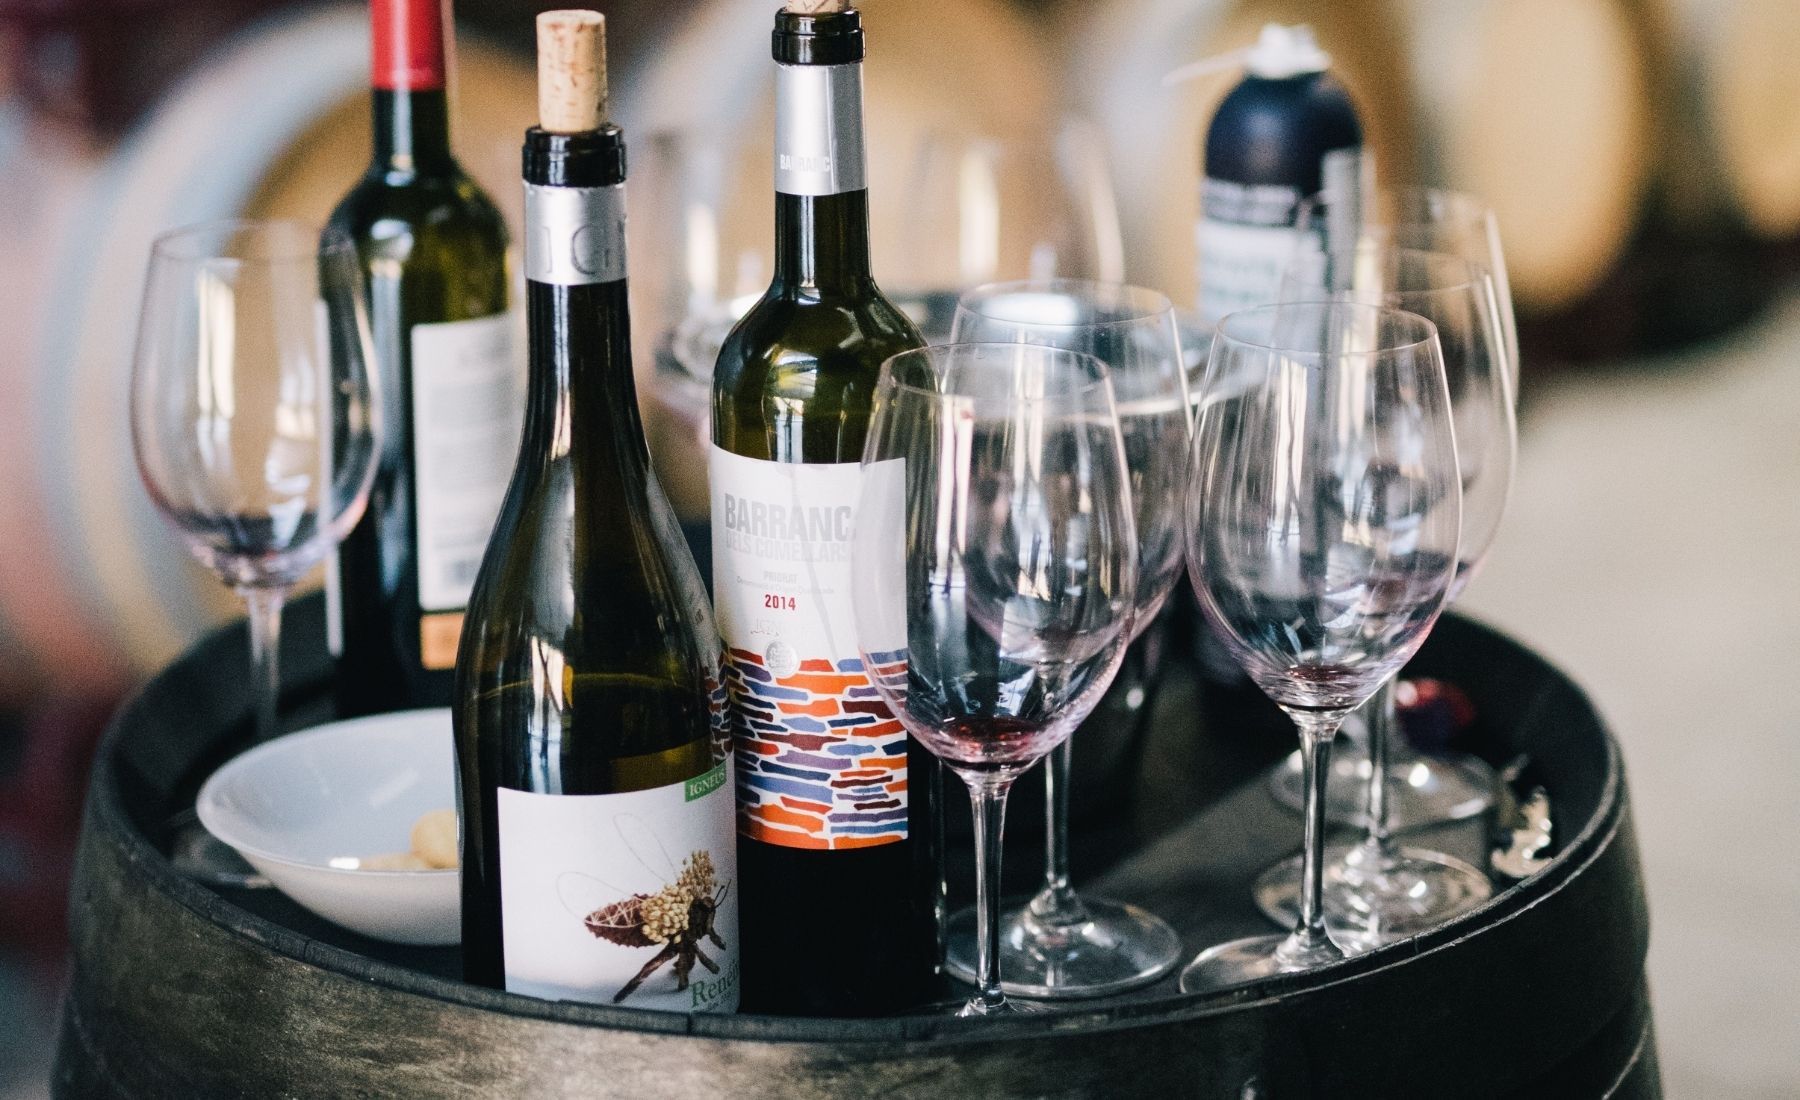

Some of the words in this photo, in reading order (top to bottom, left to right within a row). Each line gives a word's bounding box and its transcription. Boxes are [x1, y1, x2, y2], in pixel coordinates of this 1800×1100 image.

[725, 493, 852, 541] BARRANC
[764, 594, 796, 611] 2014
[690, 770, 725, 796] IGNEUS
